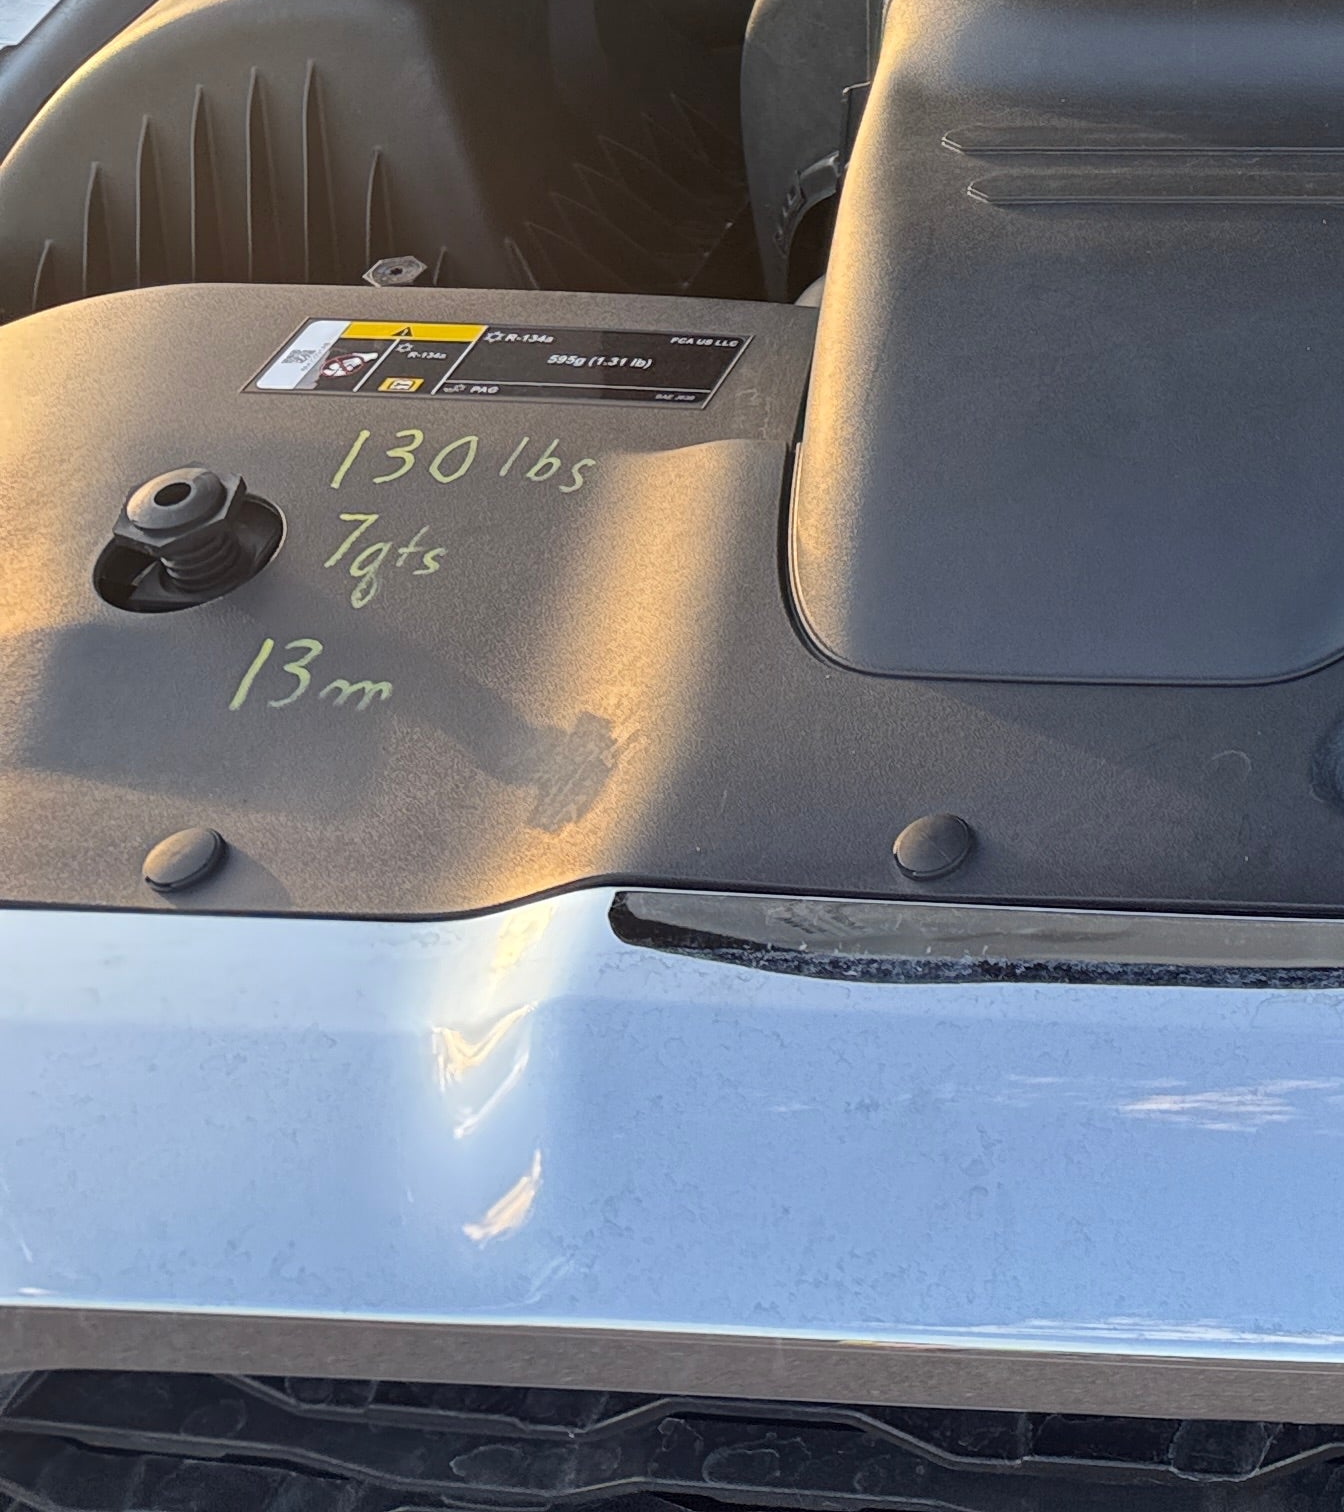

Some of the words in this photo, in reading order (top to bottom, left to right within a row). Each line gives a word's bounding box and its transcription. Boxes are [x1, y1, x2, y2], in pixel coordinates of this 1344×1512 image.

[504, 333, 554, 343] R-134a
[714, 339, 739, 347] LLC
[407, 351, 447, 360] R-134a
[547, 354, 586, 367] 595g
[588, 355, 627, 368] (1.31
[629, 357, 653, 370] lb)
[330, 429, 479, 489] 130
[499, 436, 597, 493] lbs
